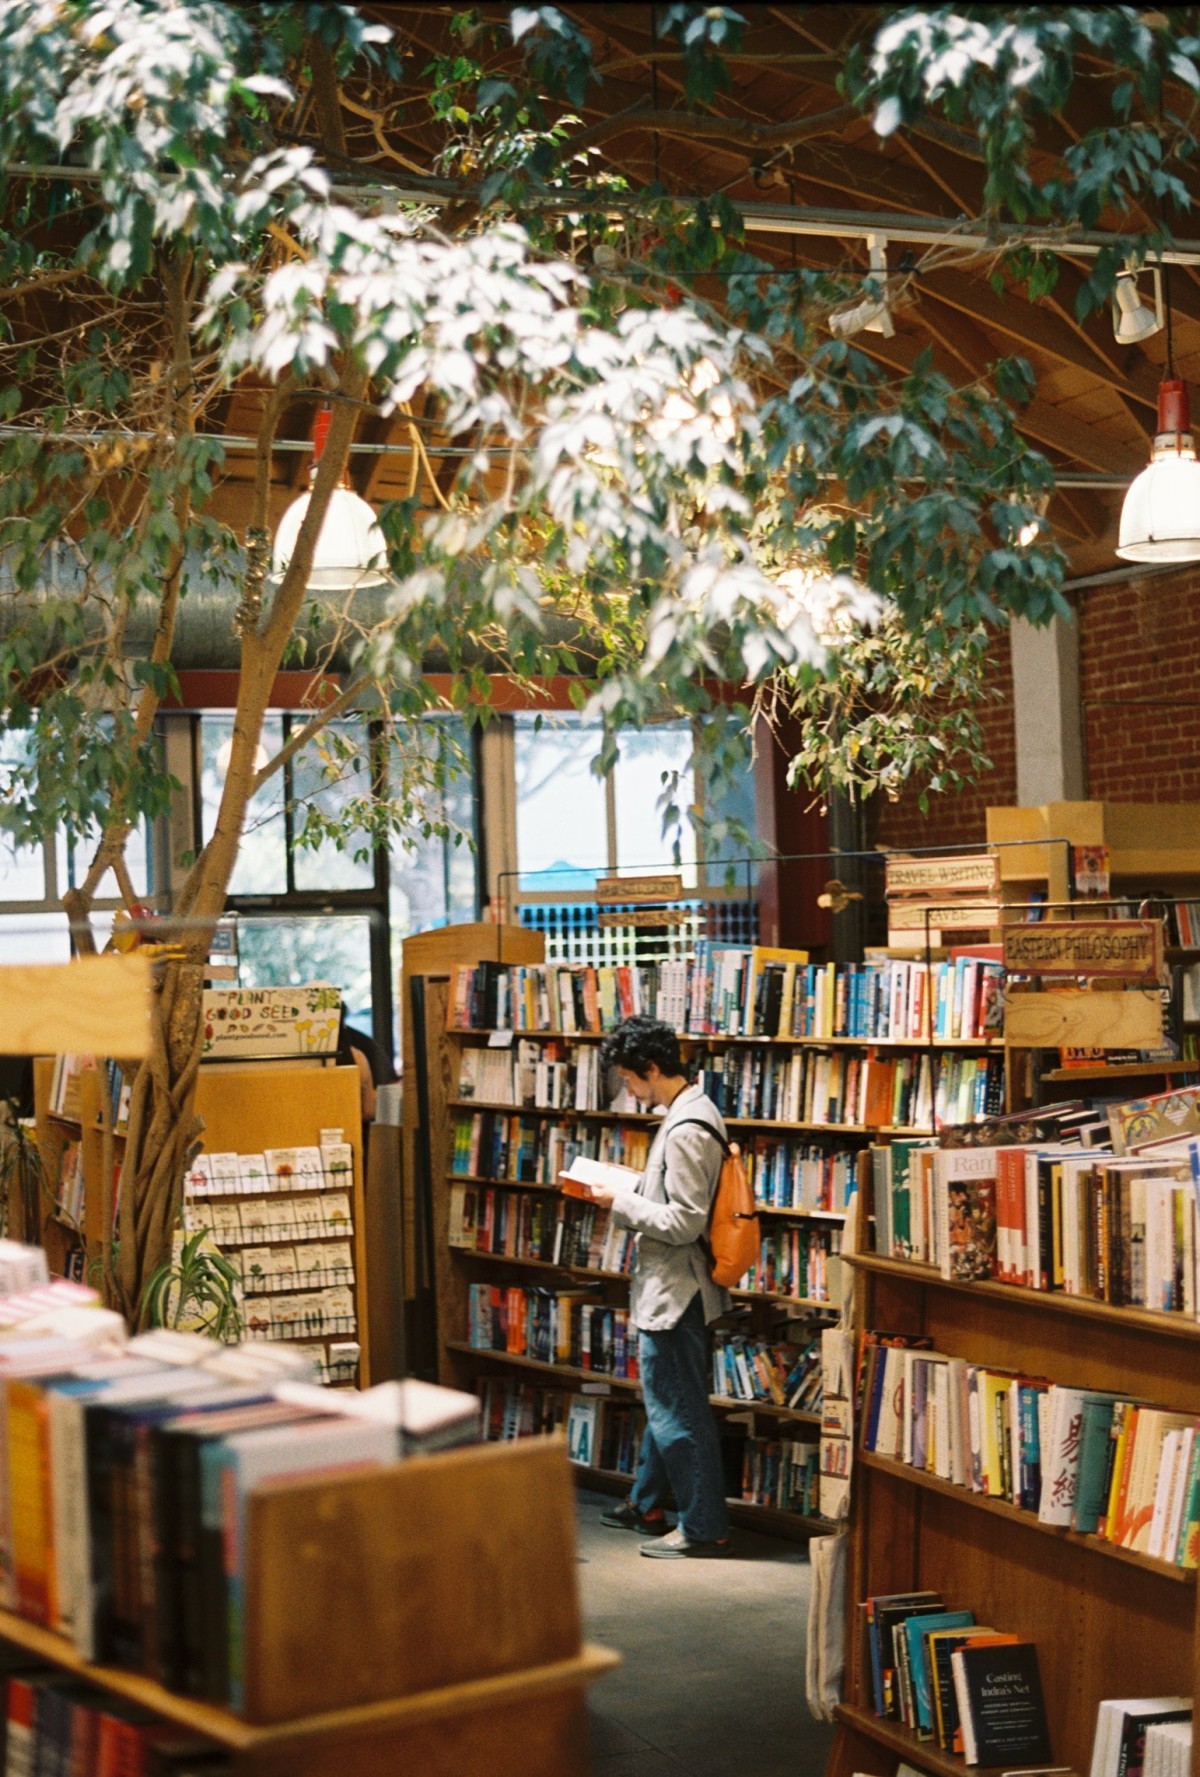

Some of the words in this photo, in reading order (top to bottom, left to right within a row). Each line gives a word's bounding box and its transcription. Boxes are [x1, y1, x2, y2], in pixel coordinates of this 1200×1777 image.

[889, 868, 935, 884] TRAVEL
[938, 865, 994, 881] WRITING
[918, 908, 968, 922] TRAVEL
[1007, 936, 1061, 960] EASTERN
[1065, 936, 1149, 960] PHILOSOPHY
[228, 990, 276, 1005] PLANT
[205, 1007, 252, 1021] GOOD
[260, 1004, 300, 1019] SEED
[985, 1672, 1023, 1684] Casting
[981, 1684, 1012, 1697] Indra's
[1013, 1684, 1031, 1695] Net
